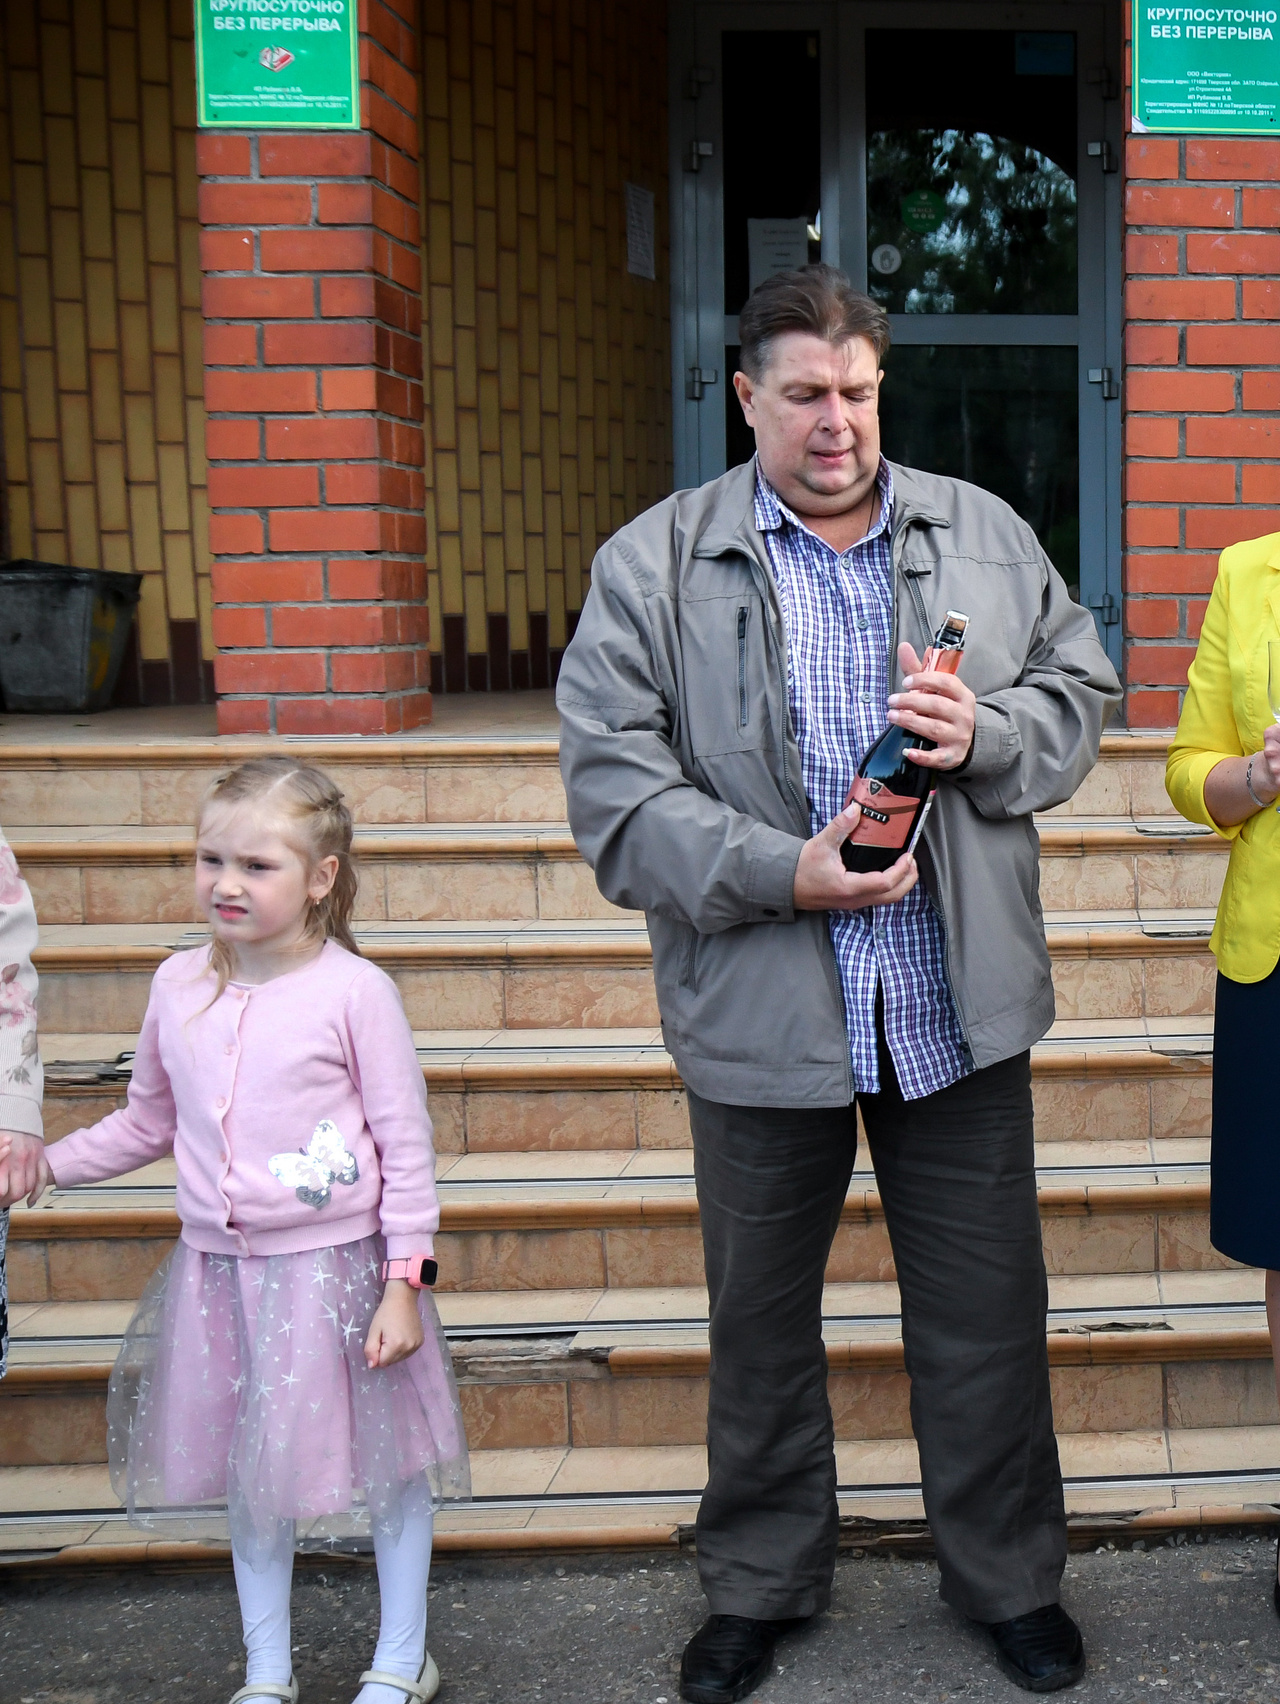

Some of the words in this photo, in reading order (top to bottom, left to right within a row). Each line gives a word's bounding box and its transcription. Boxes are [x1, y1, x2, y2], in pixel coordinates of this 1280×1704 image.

[210, 0, 345, 14] КРУГЛОСУТОЧНО
[1147, 8, 1277, 23] КРУГЛОСУТОЧНО
[213, 16, 246, 30] БЕЗ
[250, 16, 342, 32] ПЕРЕРЫВА
[1150, 25, 1181, 38] БЕЗ
[1186, 25, 1273, 40] ПЕРЕРЫВА
